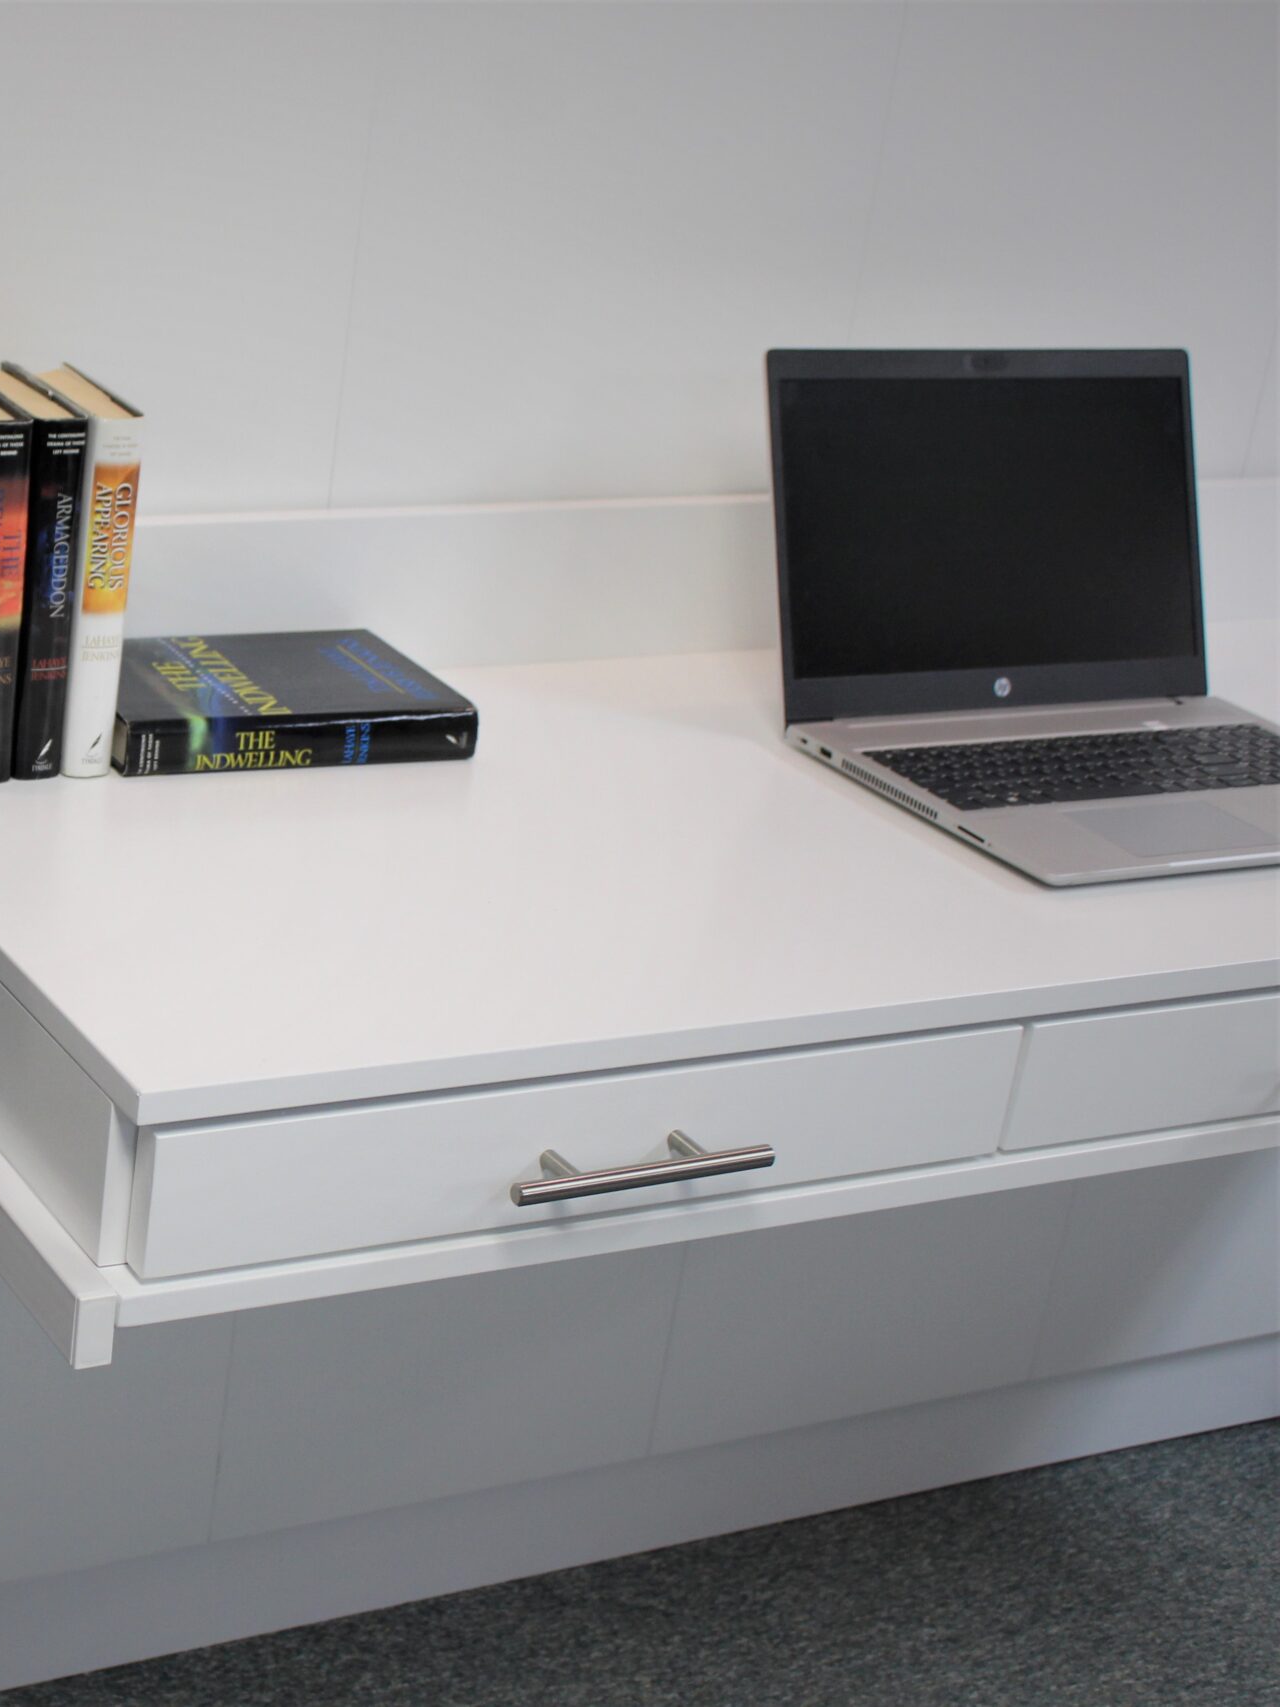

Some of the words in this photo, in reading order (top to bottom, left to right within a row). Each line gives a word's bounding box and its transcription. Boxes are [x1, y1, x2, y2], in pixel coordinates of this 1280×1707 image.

[0, 529, 21, 578] THE
[49, 491, 73, 619] ARMAGEDDON
[87, 481, 112, 590] APPEARING
[109, 482, 132, 591] GLORIOUS
[151, 661, 207, 691] THE
[195, 748, 312, 770] INDWELLING
[235, 730, 275, 750] THE
